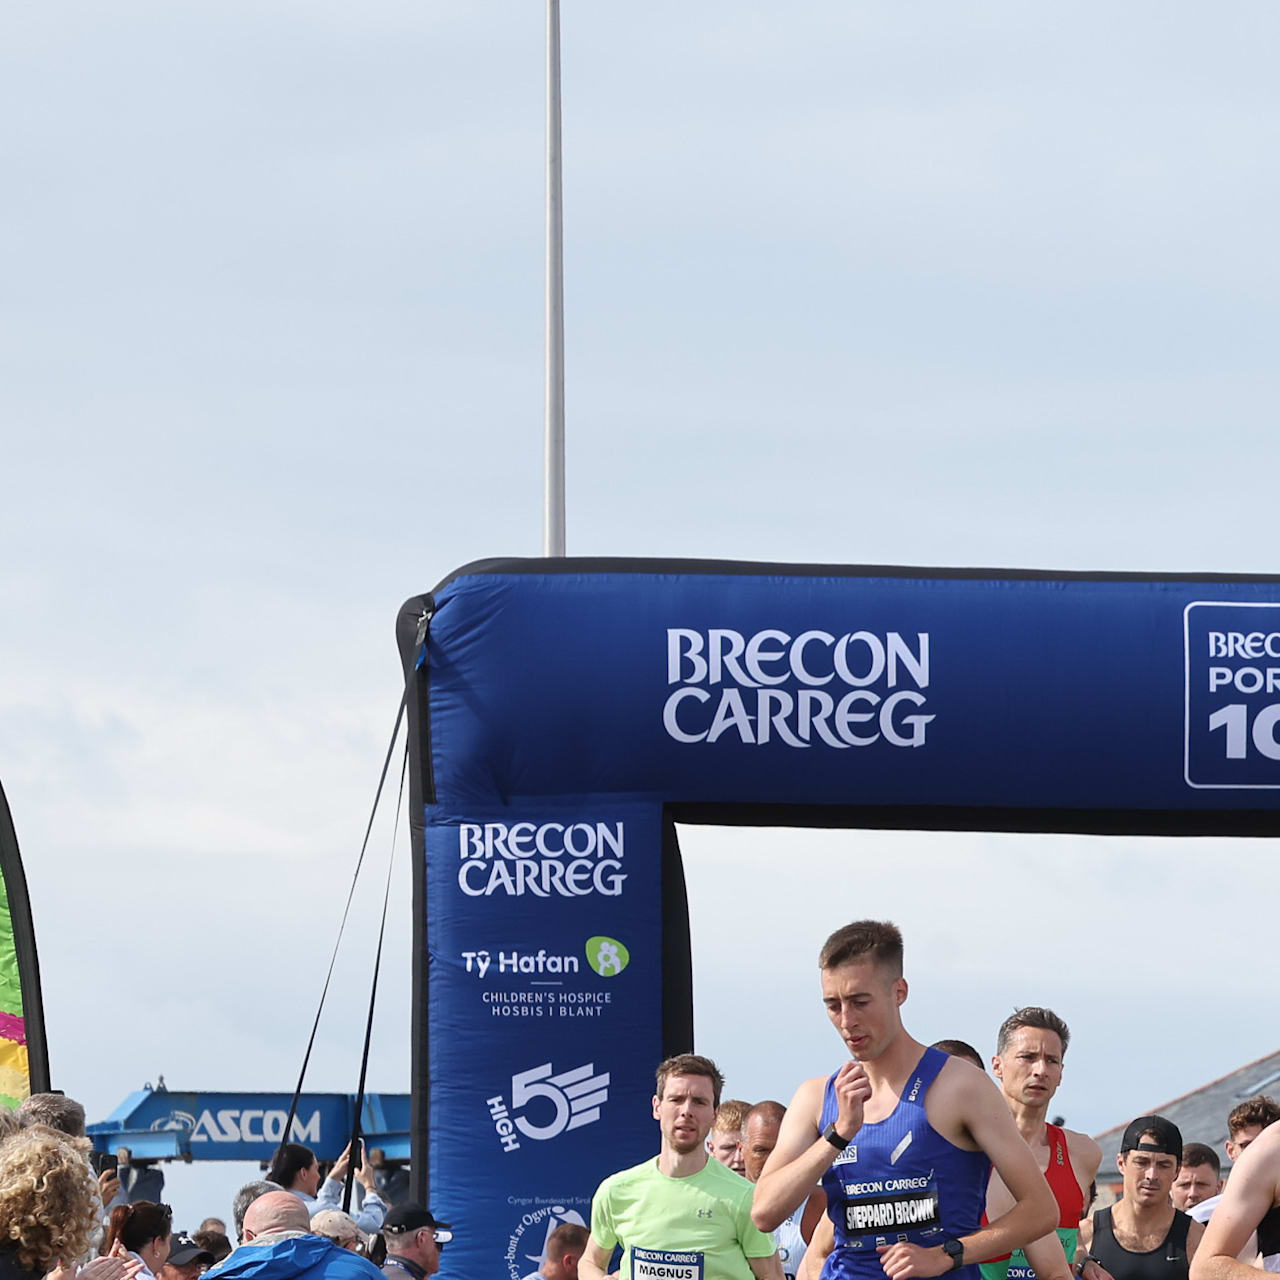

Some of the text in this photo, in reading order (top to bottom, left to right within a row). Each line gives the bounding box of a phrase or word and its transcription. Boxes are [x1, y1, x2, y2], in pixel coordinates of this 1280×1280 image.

[667, 628, 930, 688] BRECON
[662, 688, 936, 748] CARREG
[459, 822, 624, 860] BRECON
[458, 859, 627, 897] CARREG
[499, 950, 579, 973] Hafan
[482, 992, 611, 1003] CHILDREN'S HOSPICE
[492, 1006, 602, 1016] HOSBIS I BLANT
[190, 1109, 321, 1143] ASCOM
[486, 1095, 521, 1153] HIGH
[846, 1177, 929, 1196] BRECON CARREG
[522, 1206, 552, 1225] Ogwr
[846, 1197, 935, 1230] SHEPPARD BROWN
[634, 1248, 698, 1264] BRECON CARREG
[639, 1264, 693, 1280] MAGNUS
